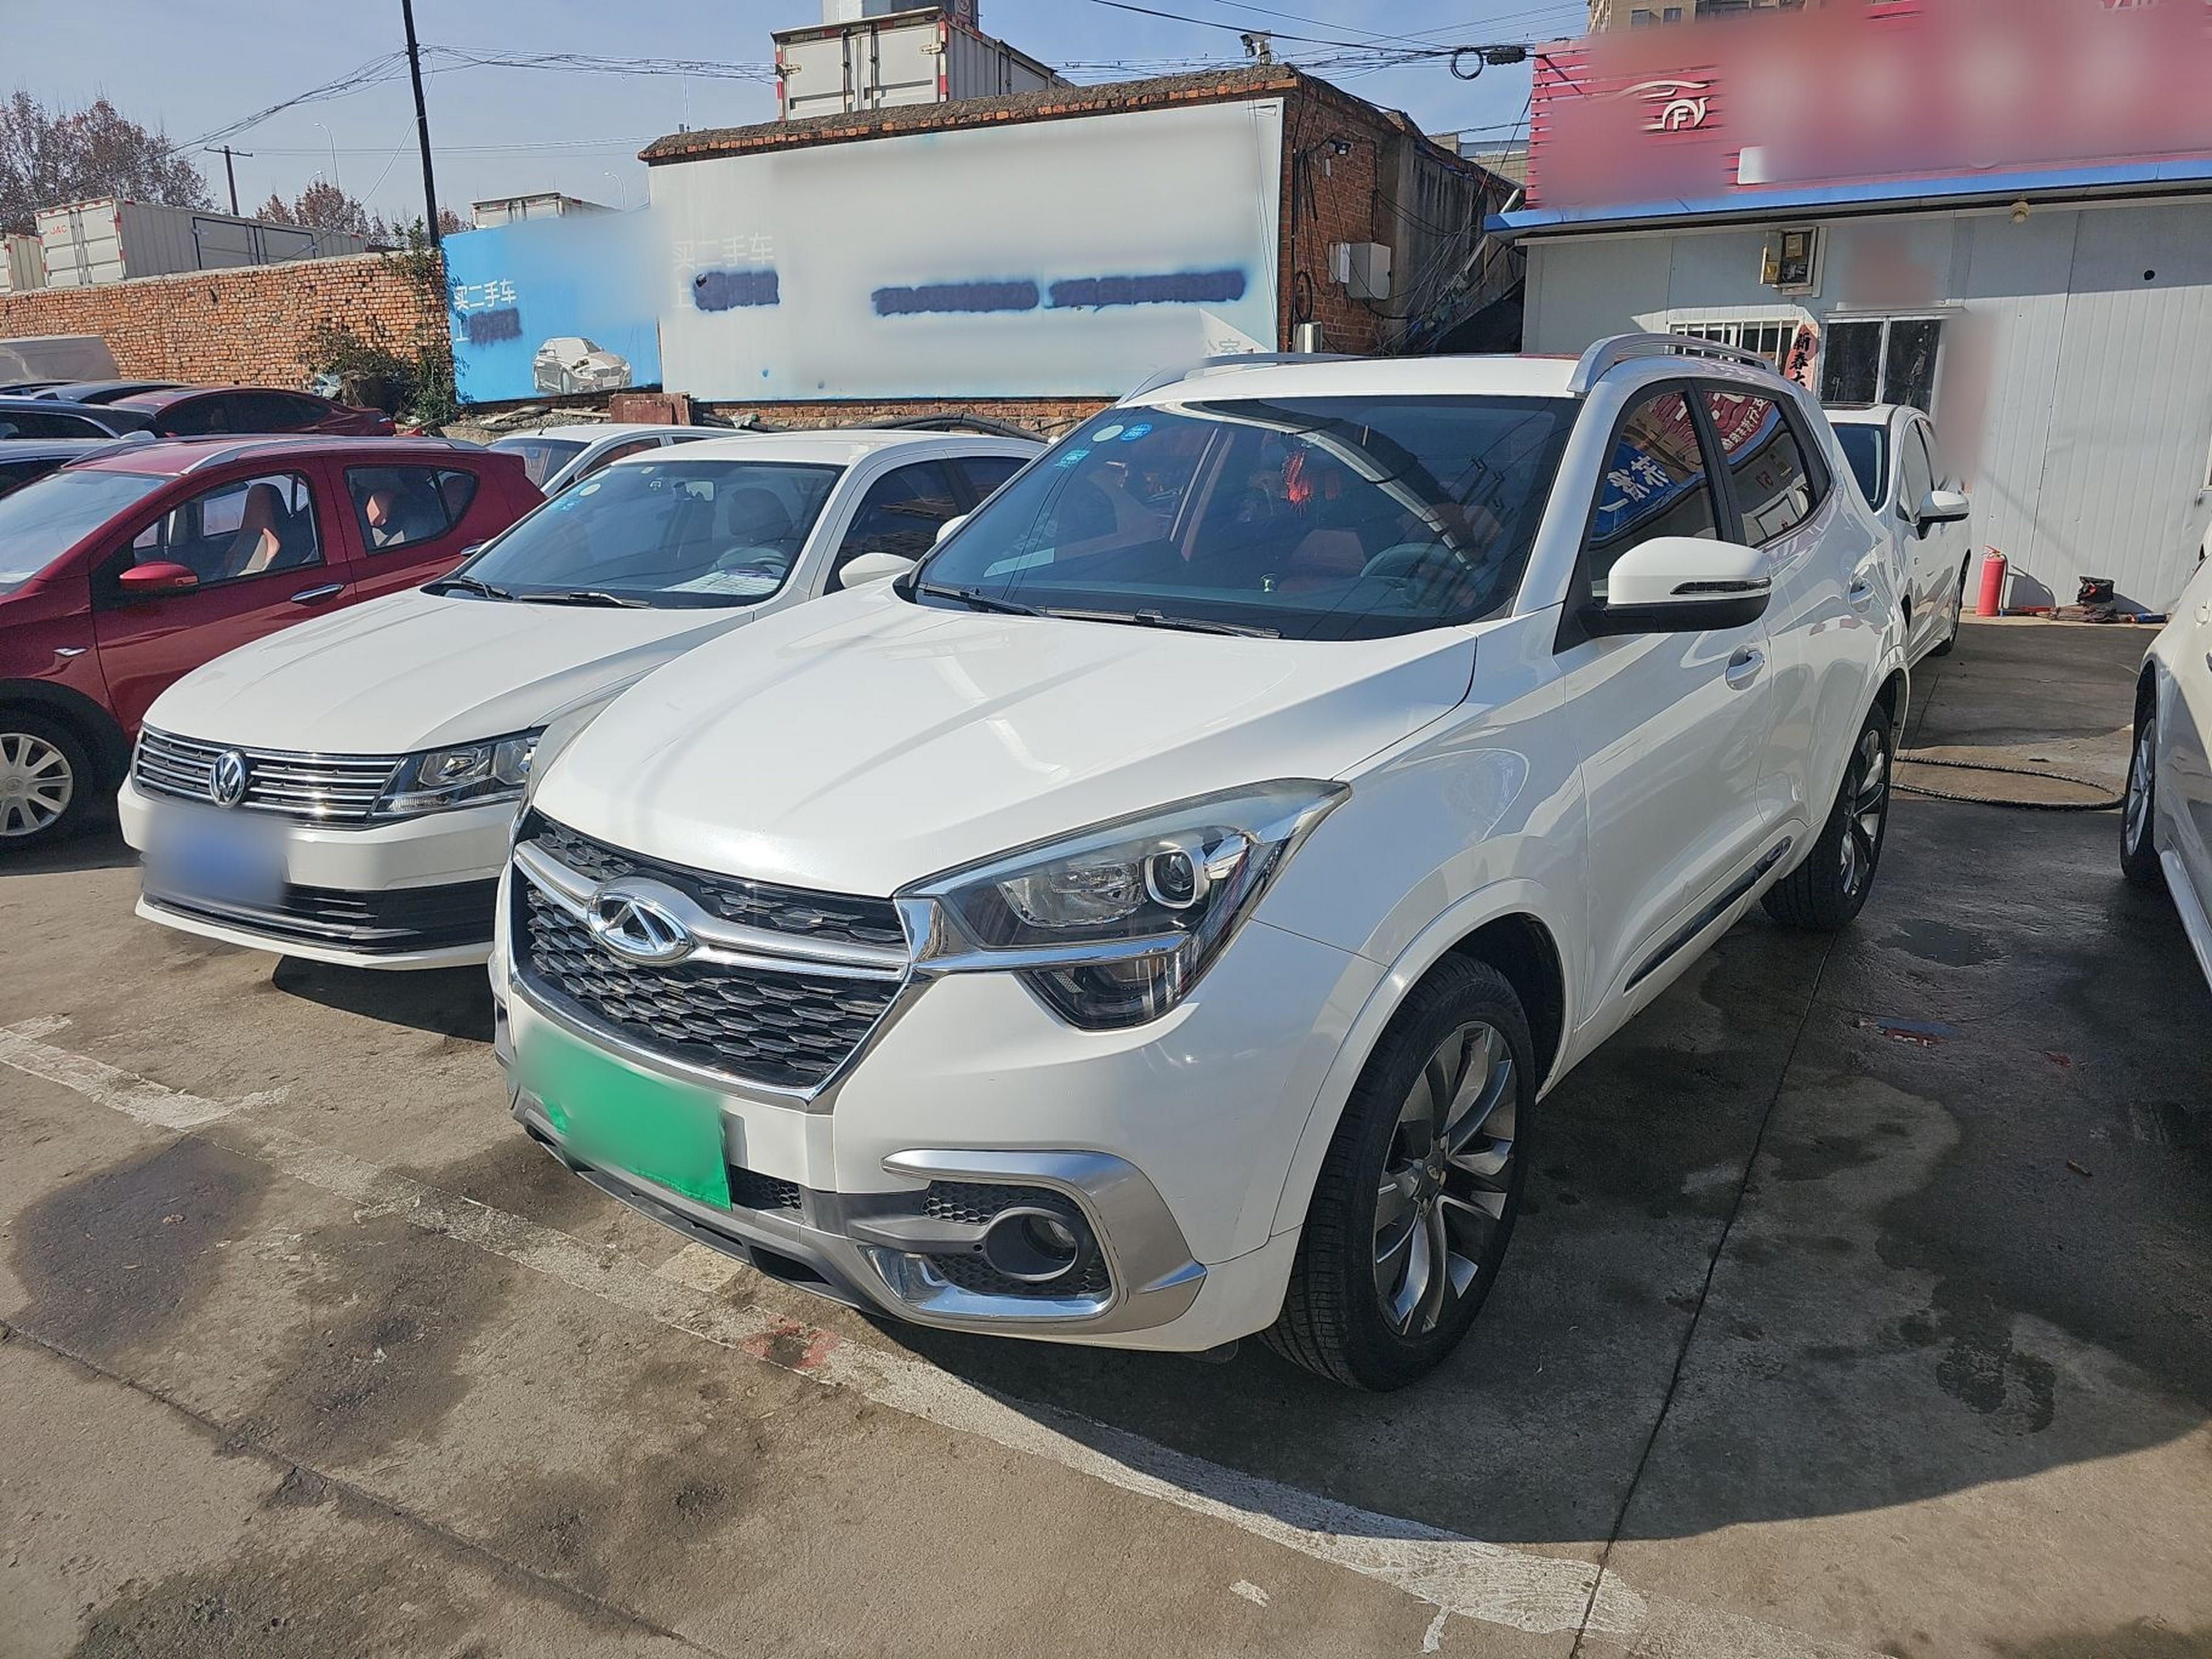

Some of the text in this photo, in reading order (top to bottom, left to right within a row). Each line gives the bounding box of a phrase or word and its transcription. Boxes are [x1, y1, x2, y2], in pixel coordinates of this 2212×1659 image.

[671, 233, 776, 270] 买二手车
[454, 278, 517, 310] 买二手车
